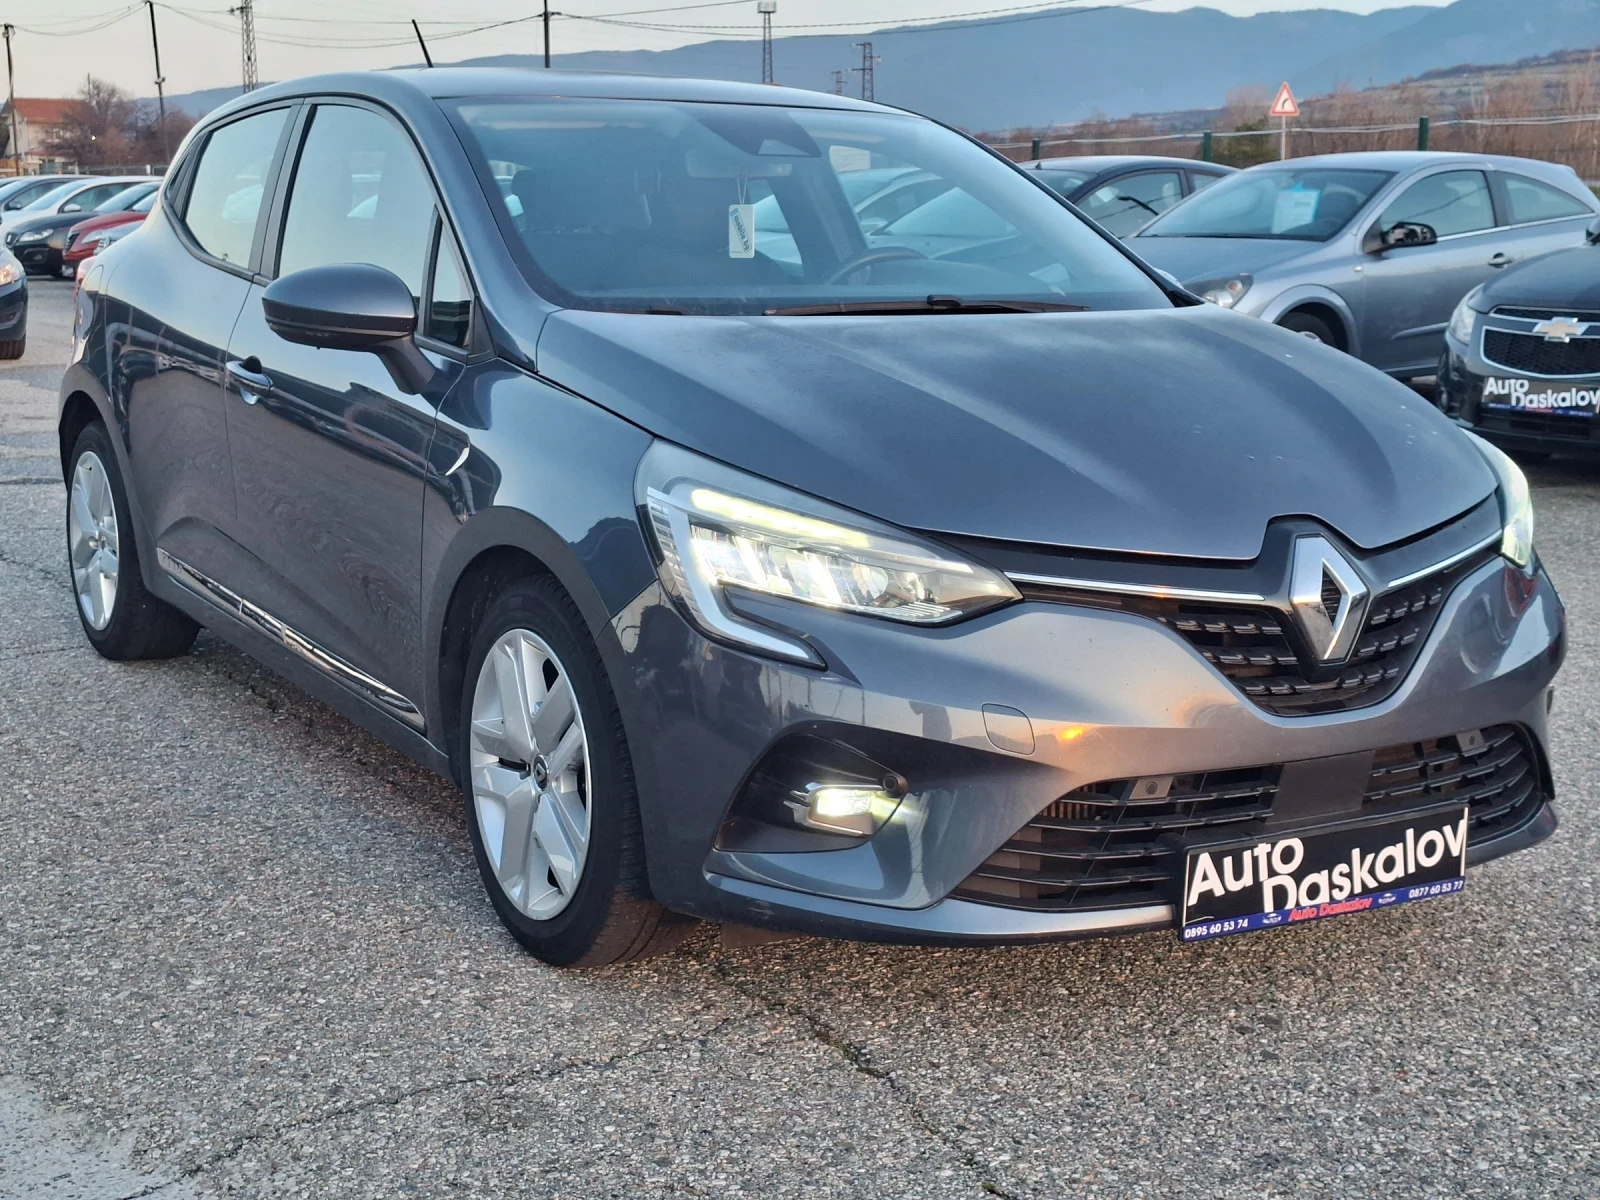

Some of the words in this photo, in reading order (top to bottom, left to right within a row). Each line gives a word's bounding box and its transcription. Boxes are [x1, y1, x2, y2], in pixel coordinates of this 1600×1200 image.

[1485, 377, 1529, 396] Auto
[1511, 387, 1600, 409] Daskalov
[1187, 837, 1305, 907] Auto
[1262, 818, 1467, 913] Daskalov
[1408, 885, 1429, 899] 0877
[1430, 884, 1441, 895] 60
[1441, 883, 1453, 893] 53
[1453, 880, 1464, 890] 77
[1288, 906, 1318, 922] Auto
[1319, 898, 1373, 916] Daskalov
[1184, 926, 1208, 938] 0895
[1209, 923, 1222, 934] 60
[1223, 921, 1235, 931] 53
[1237, 918, 1249, 928] 74
